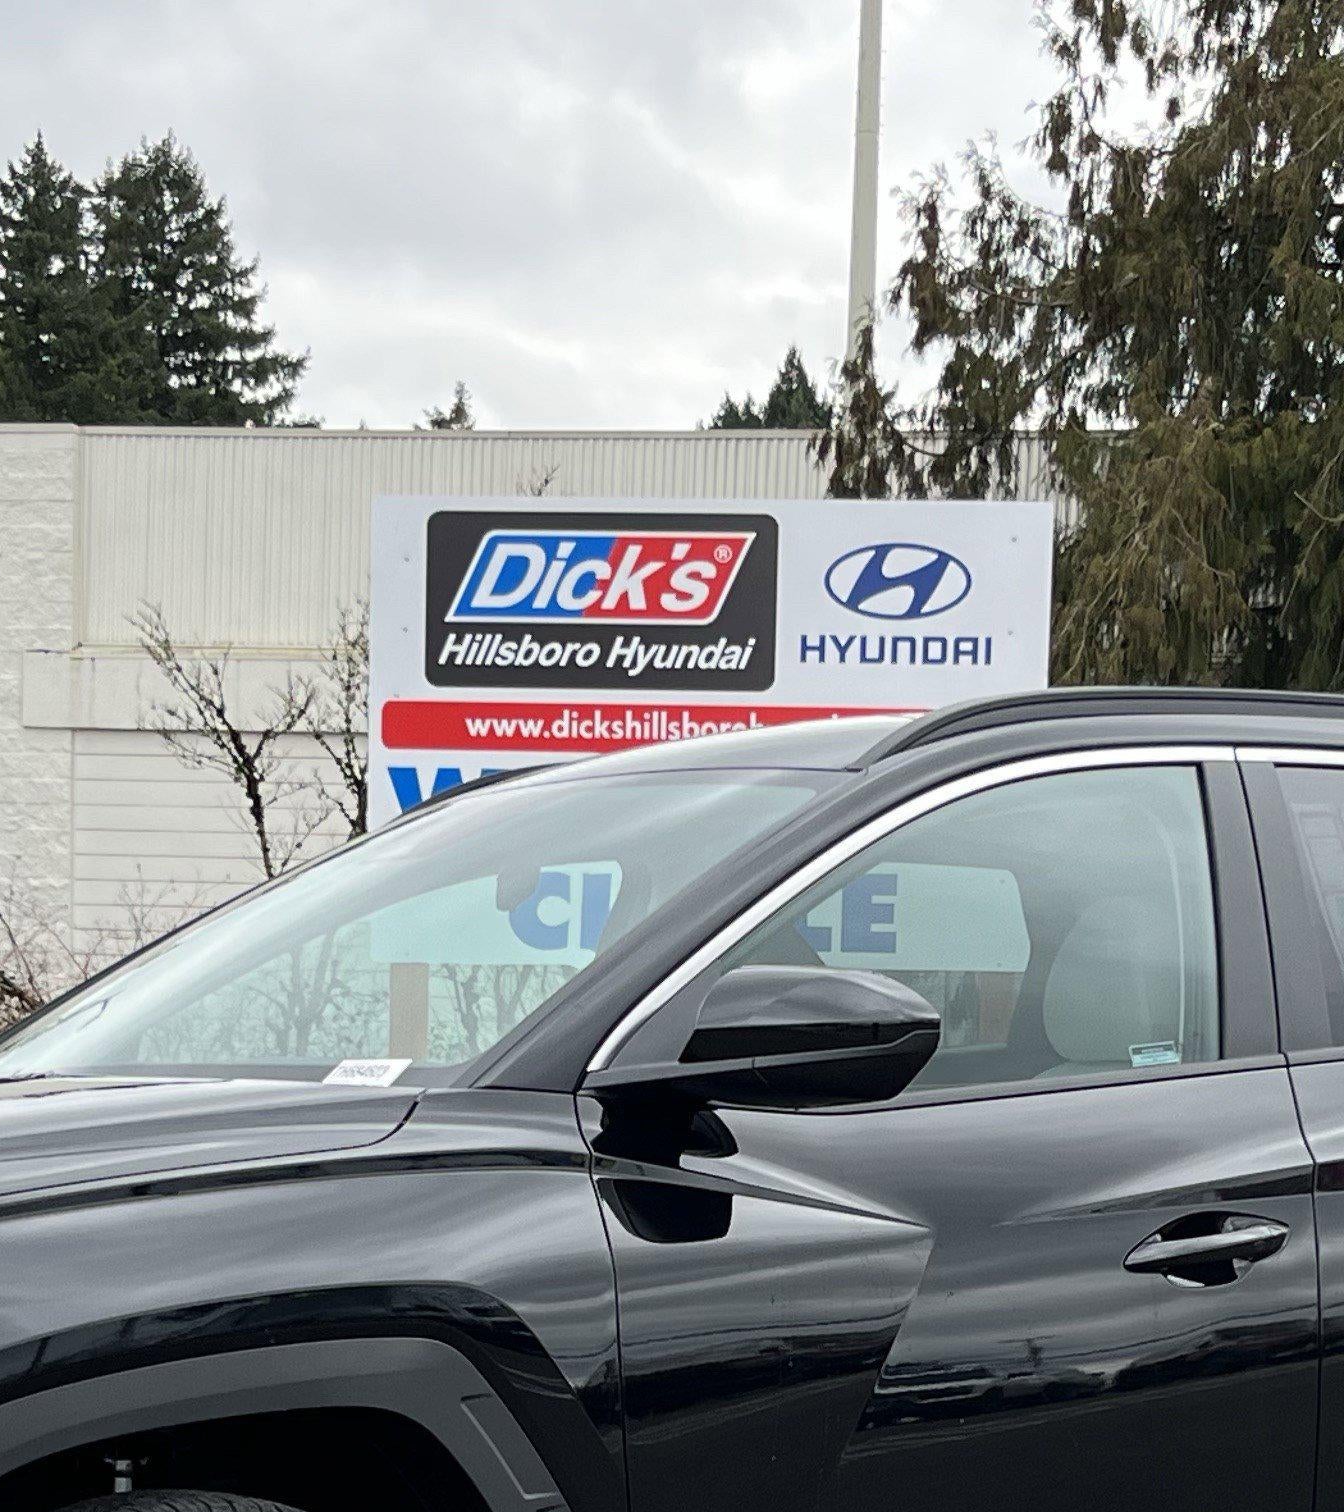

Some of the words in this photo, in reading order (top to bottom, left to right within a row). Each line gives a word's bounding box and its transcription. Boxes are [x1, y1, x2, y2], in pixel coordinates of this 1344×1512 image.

[470, 541, 717, 612] Dick's
[438, 633, 603, 668] Hillsboro
[605, 636, 756, 677] Hyundai
[800, 635, 992, 666] HYUNDAI
